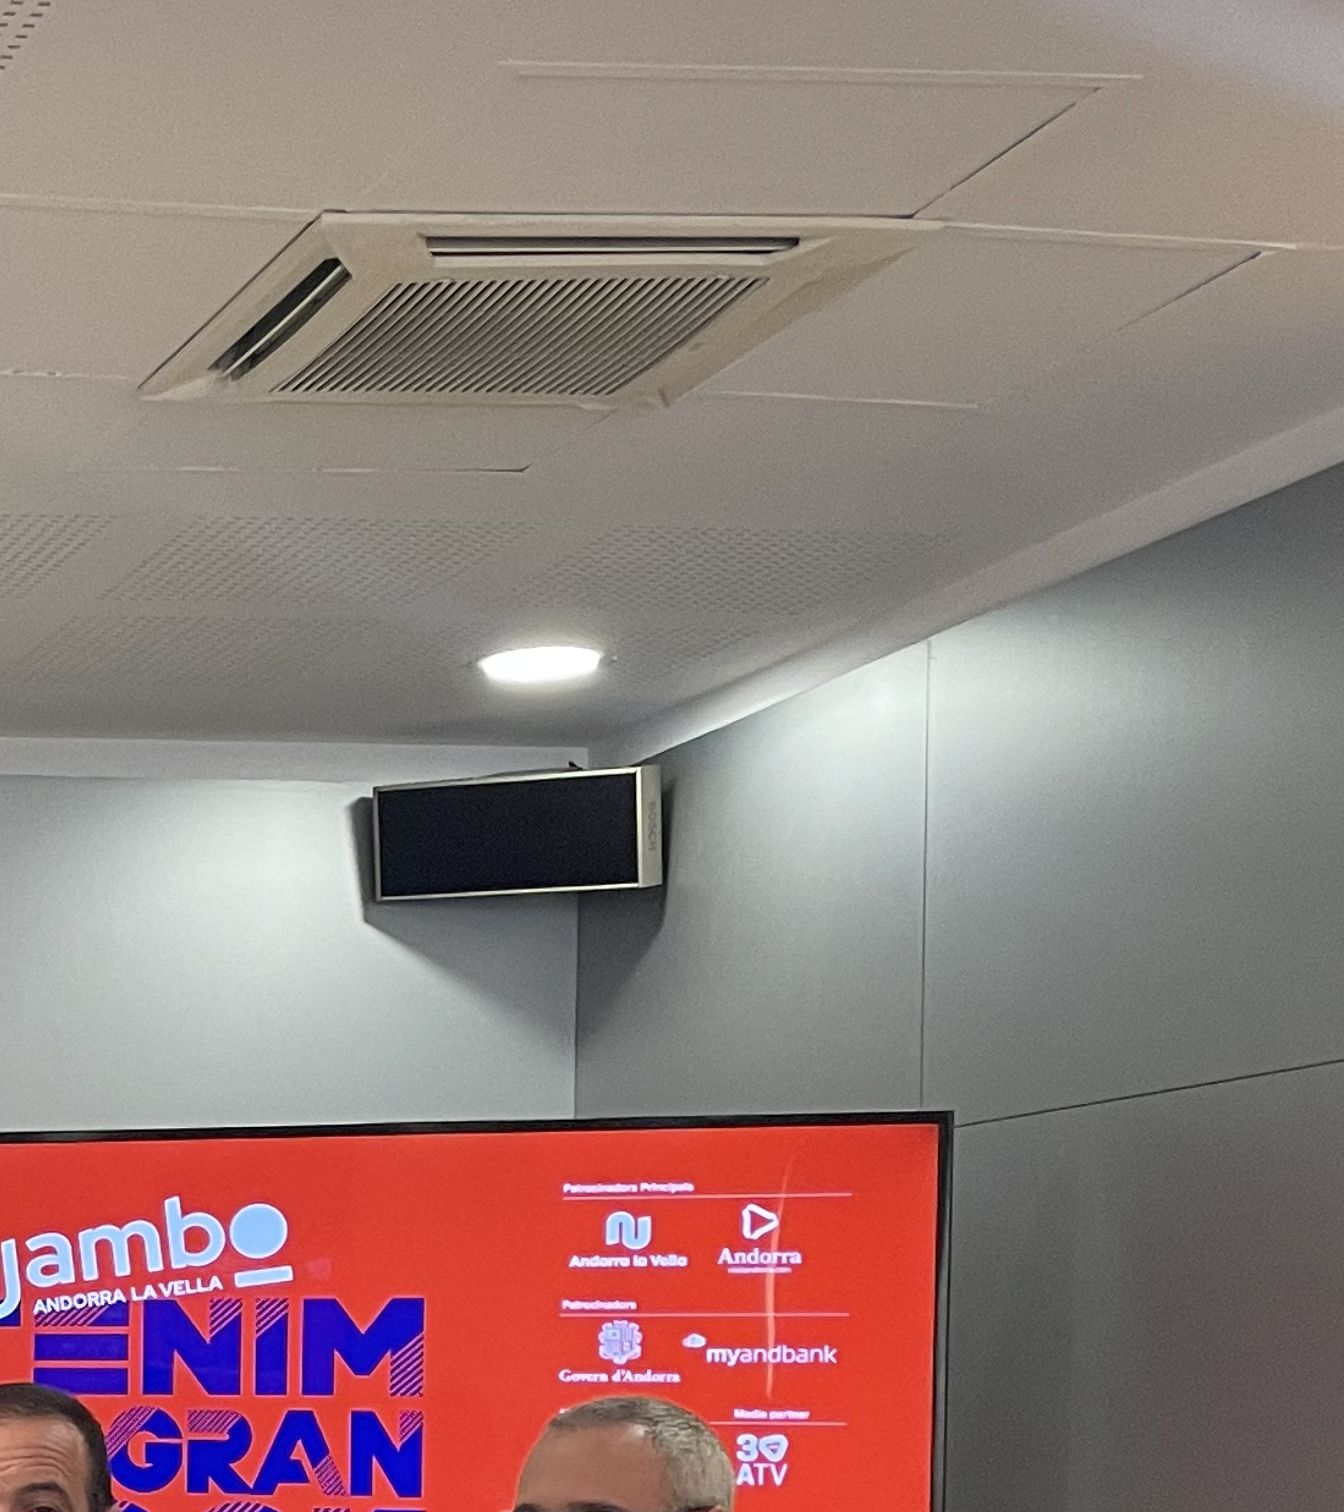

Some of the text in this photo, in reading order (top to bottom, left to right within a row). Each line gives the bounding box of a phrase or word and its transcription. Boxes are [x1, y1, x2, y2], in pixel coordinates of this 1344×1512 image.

[568, 1254, 631, 1268] Andorra
[717, 1247, 803, 1265] Andorra
[32, 1274, 224, 1316] ANDORRA LA VELLA
[706, 1345, 838, 1367] myandbank
[107, 1404, 426, 1500] GRAN
[736, 1463, 788, 1487] ATV
